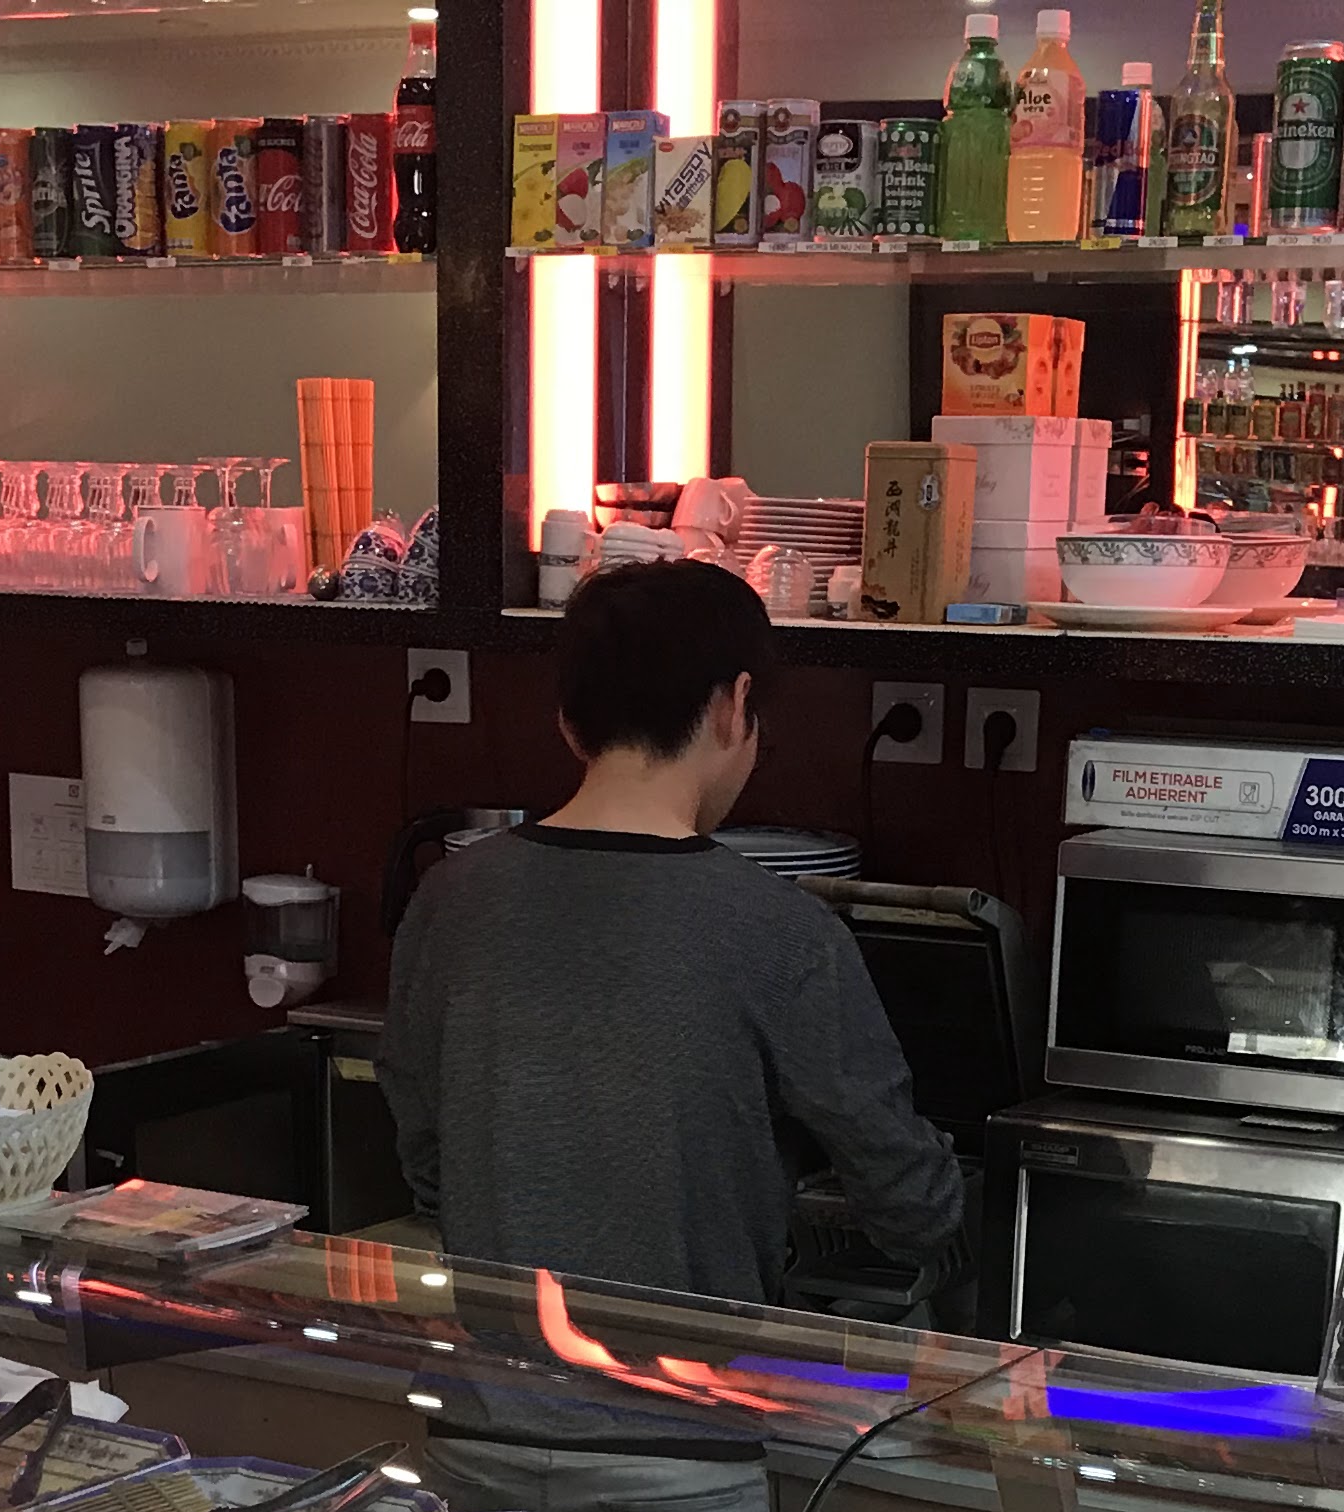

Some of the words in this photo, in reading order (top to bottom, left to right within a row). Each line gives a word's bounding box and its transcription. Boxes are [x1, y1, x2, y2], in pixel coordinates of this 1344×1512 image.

[1017, 90, 1052, 105] Aloe
[1274, 121, 1336, 139] eineken
[115, 136, 137, 239] ORANGINA
[169, 152, 199, 219] Fanta
[885, 174, 926, 187] Drink
[81, 149, 111, 233] Sprite
[217, 147, 256, 234] Fanta
[1112, 769, 1148, 785] FILM
[1150, 771, 1223, 789] ETIRABLE
[1126, 788, 1208, 804] ADHERENT
[1292, 824, 1318, 838] 300
